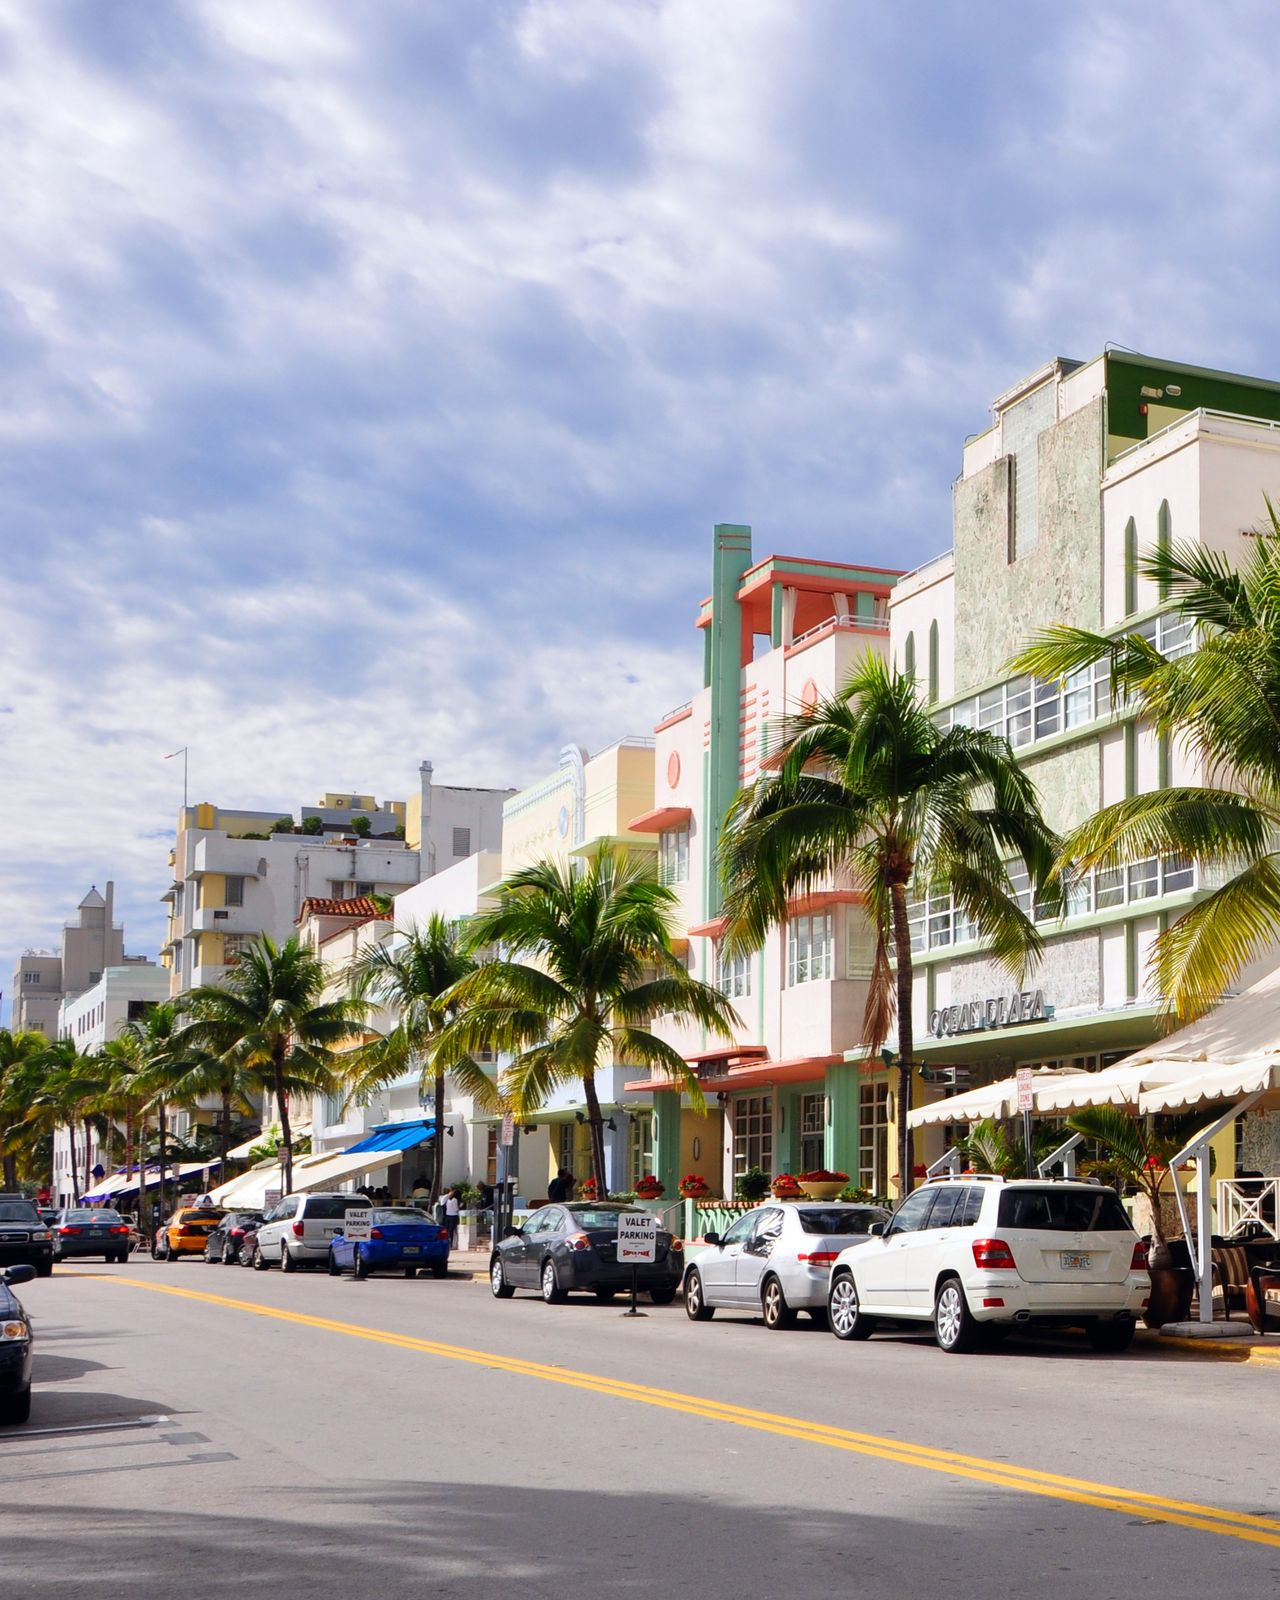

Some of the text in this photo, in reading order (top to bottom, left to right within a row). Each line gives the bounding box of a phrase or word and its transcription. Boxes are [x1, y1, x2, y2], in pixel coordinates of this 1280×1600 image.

[929, 989, 1046, 1037] OCEAN PLAZA
[625, 1217, 651, 1227] VALET
[619, 1231, 655, 1240] PARKING
